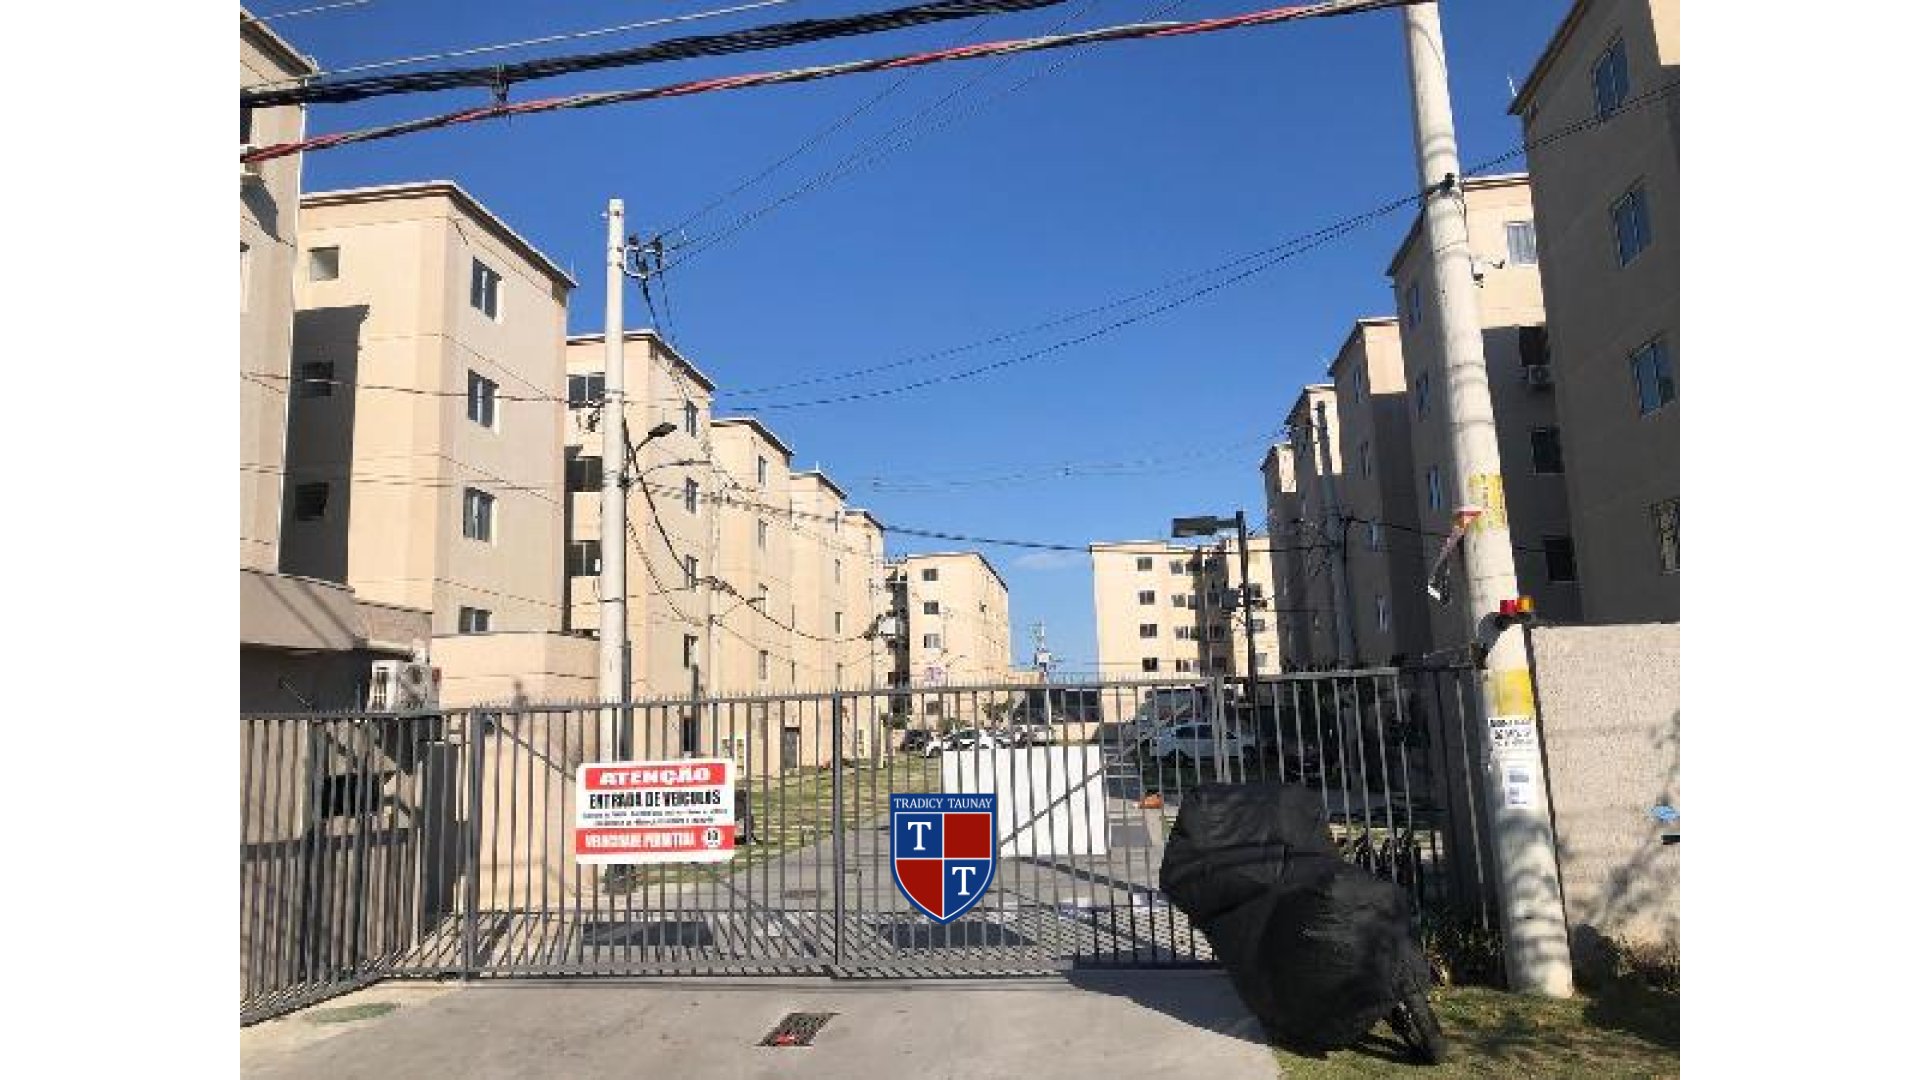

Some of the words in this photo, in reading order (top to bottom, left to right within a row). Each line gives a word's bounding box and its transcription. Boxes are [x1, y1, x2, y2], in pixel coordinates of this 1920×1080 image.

[600, 767, 711, 785] ATENÇÃO
[589, 792, 642, 809] ENTRADA
[645, 791, 661, 806] DE
